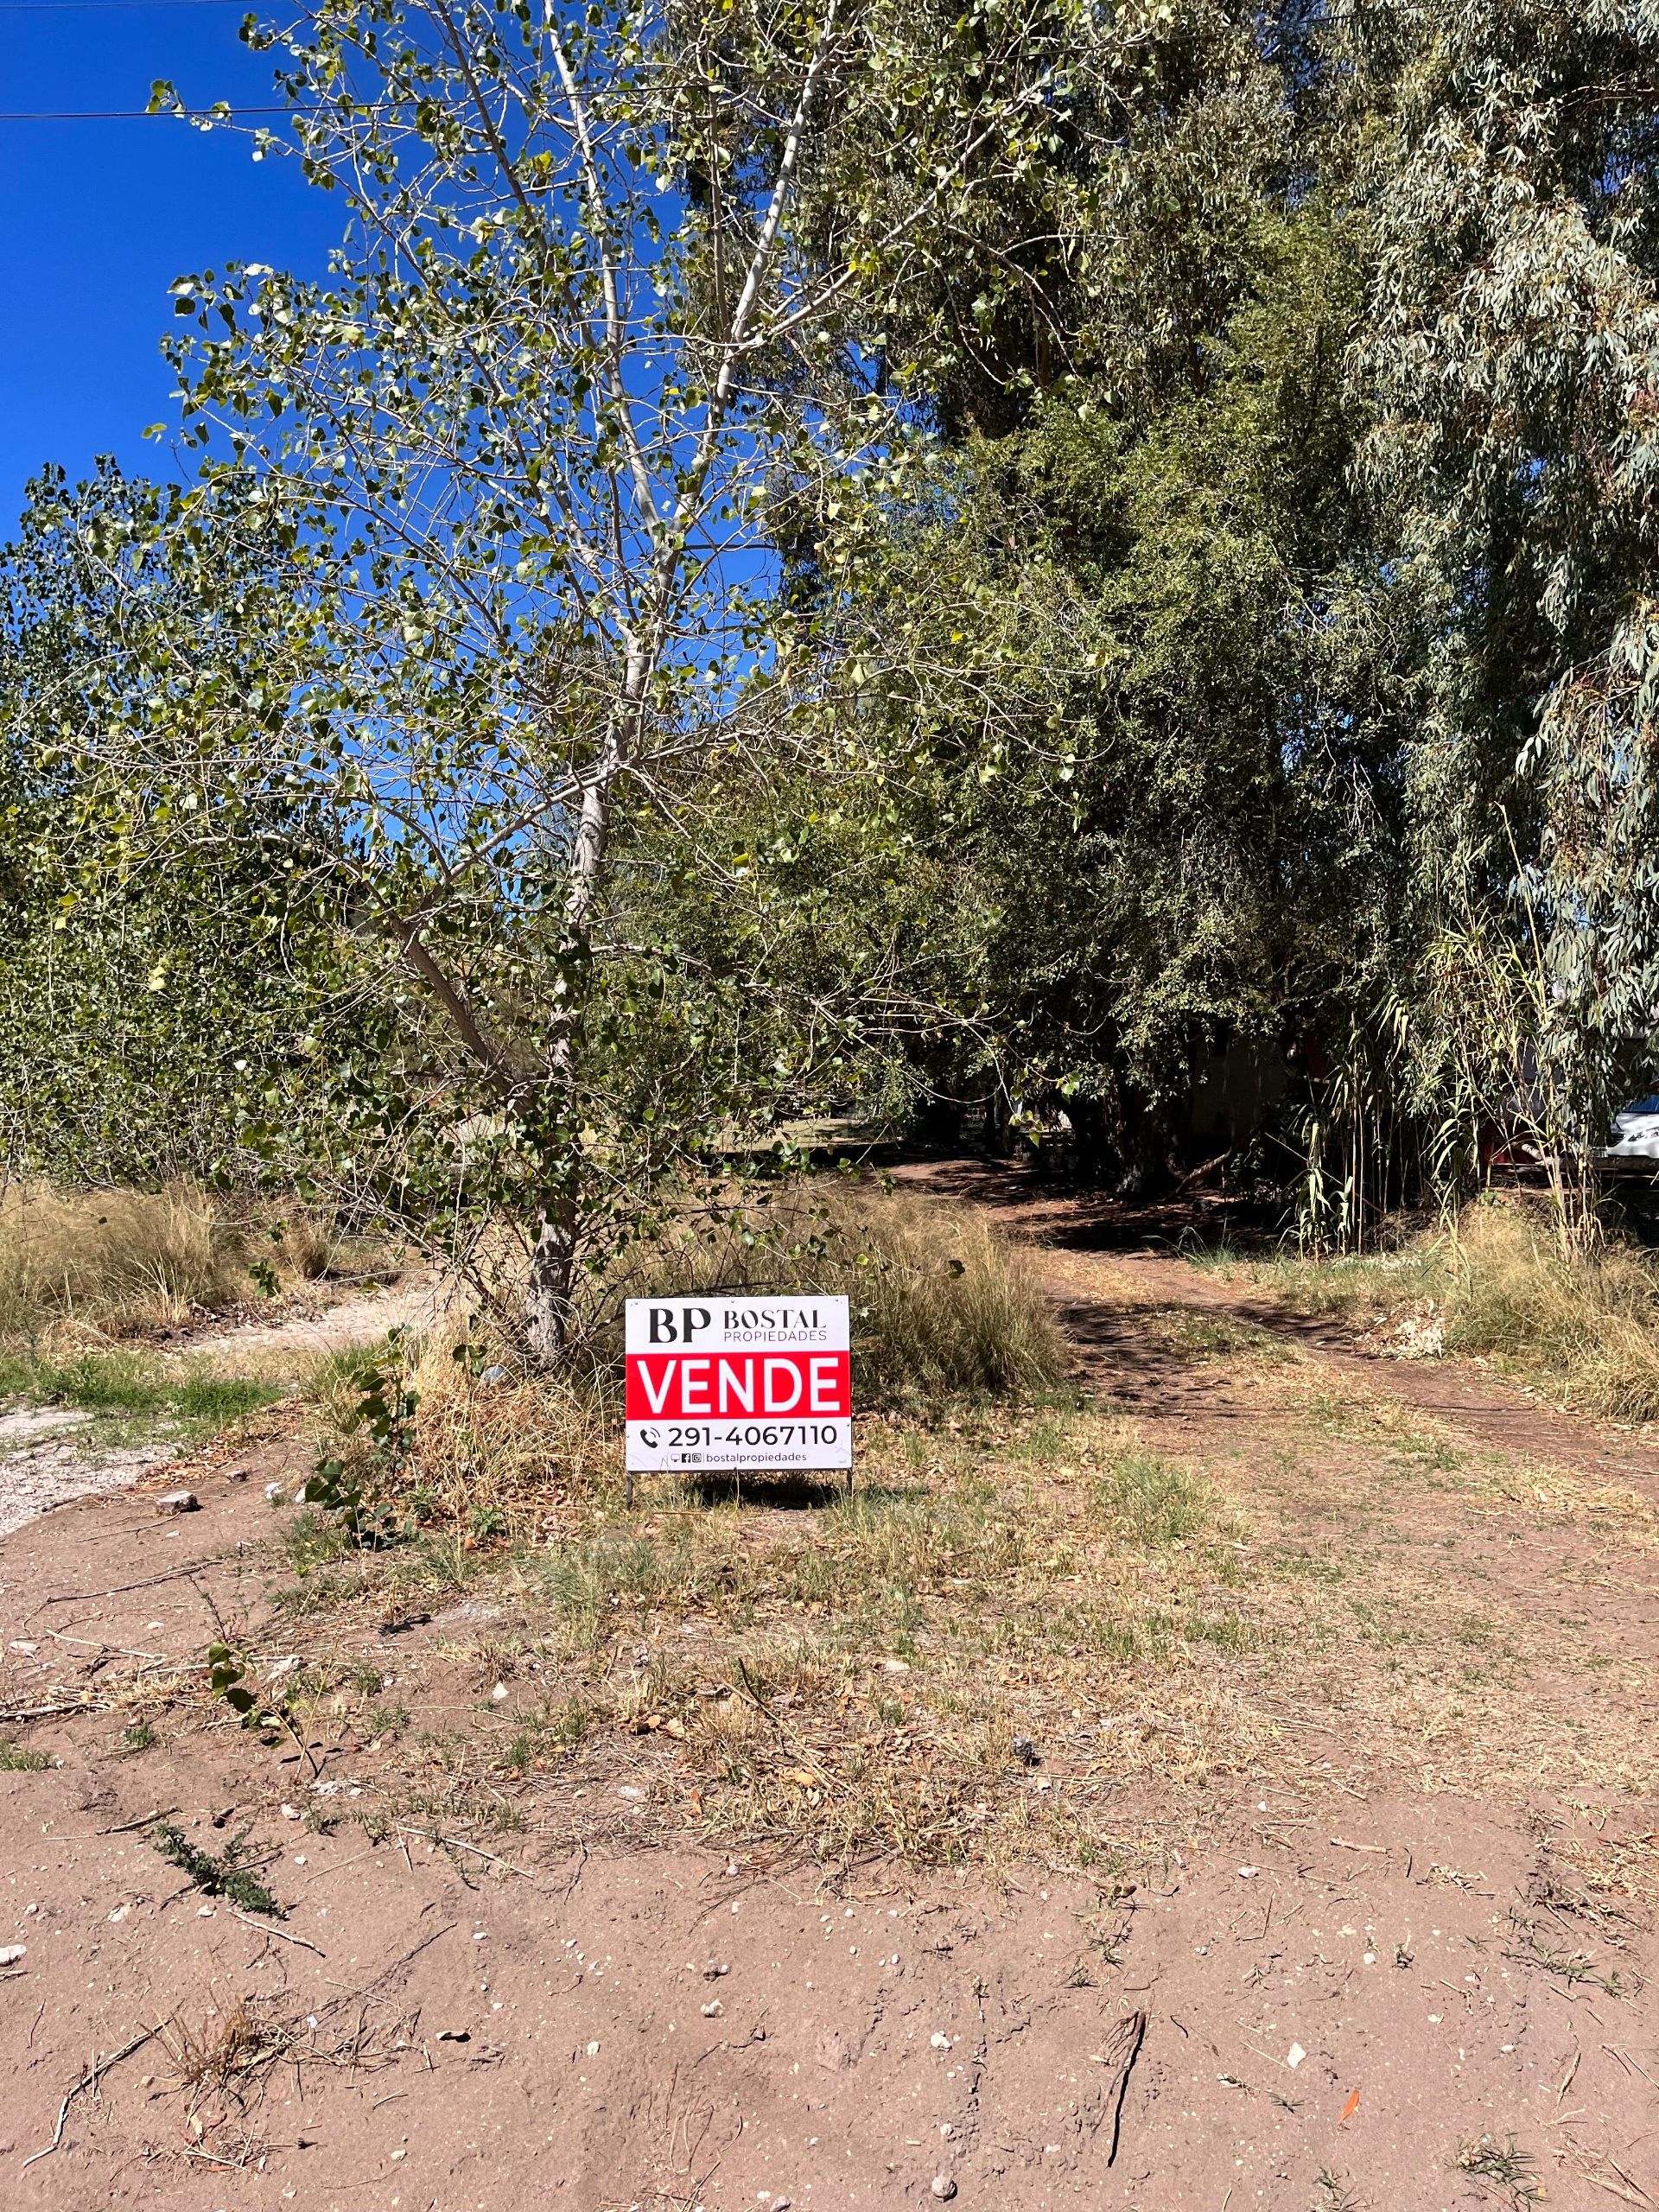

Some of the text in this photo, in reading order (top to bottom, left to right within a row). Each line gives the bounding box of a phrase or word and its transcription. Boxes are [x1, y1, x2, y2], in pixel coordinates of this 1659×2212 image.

[649, 1307, 711, 1344] BP
[724, 1309, 826, 1329] BOSTAL
[724, 1331, 827, 1342] PROPIEDADES
[636, 1357, 840, 1414] VENDE
[668, 1425, 837, 1446] 291-4067110
[706, 1452, 807, 1463] bostalpropiedades
